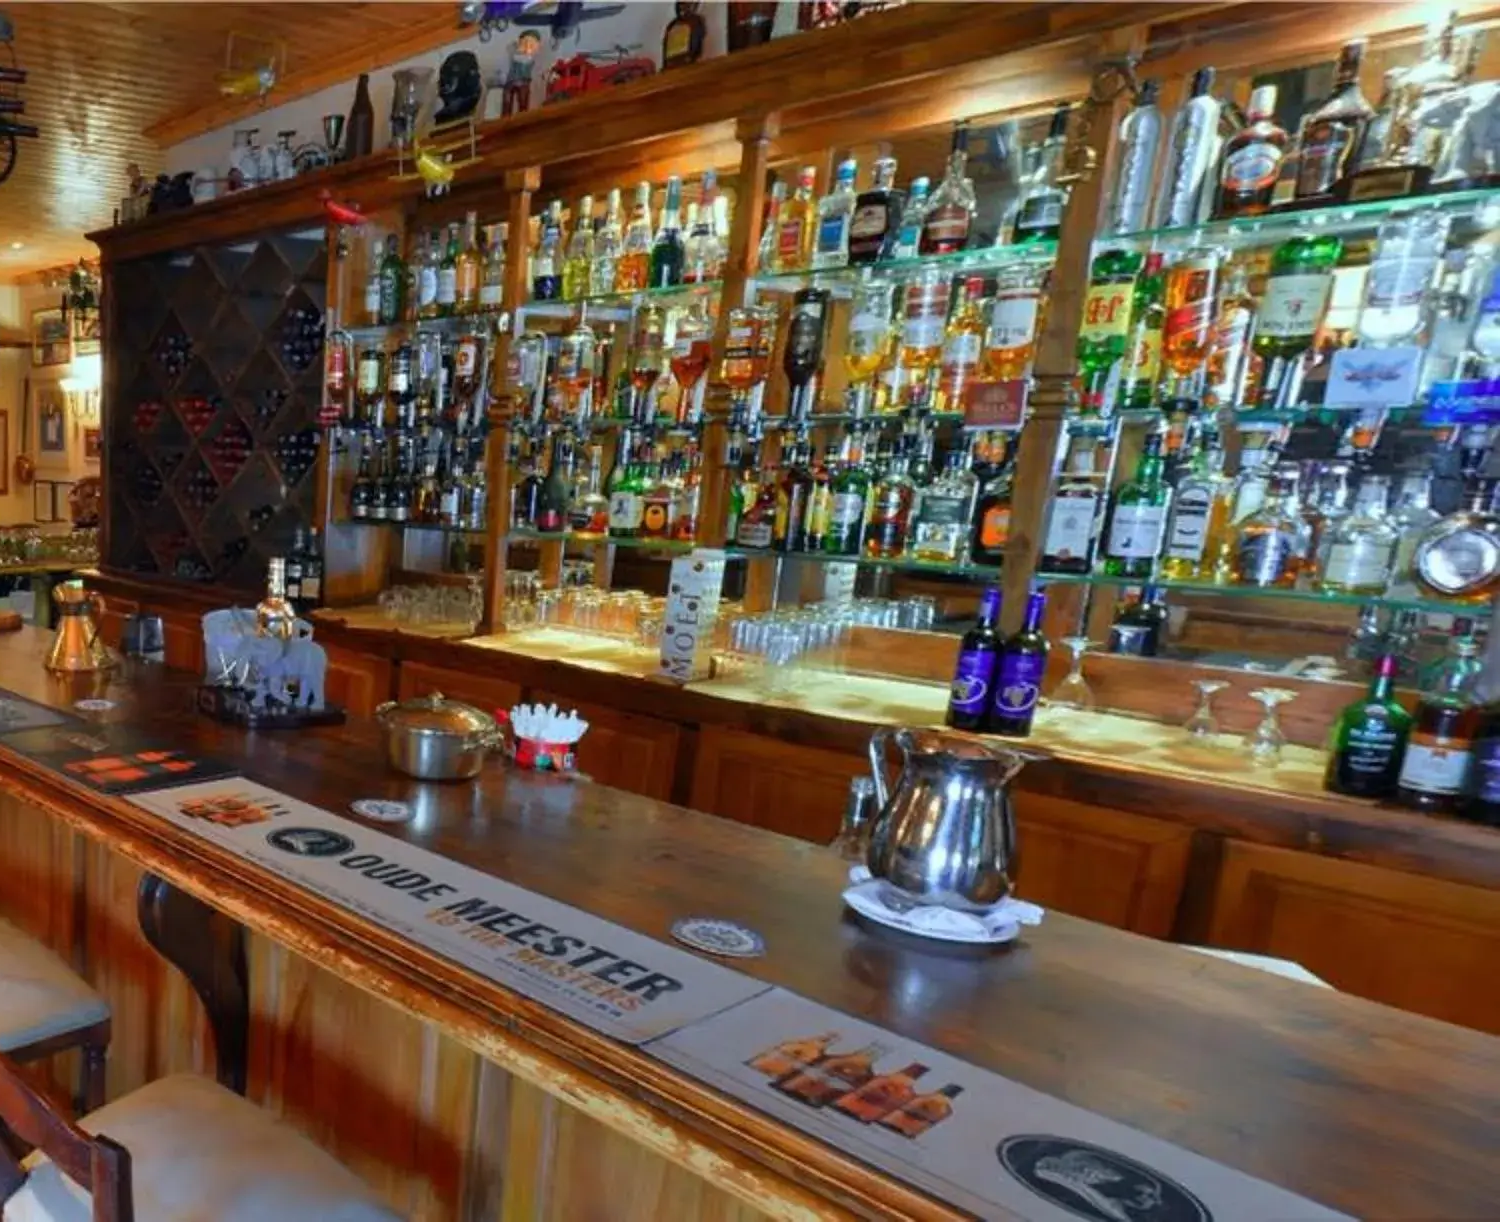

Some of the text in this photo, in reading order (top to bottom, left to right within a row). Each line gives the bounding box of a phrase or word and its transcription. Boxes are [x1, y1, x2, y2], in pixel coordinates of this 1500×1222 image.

[339, 854, 458, 902] OUDE
[443, 897, 684, 1001] MEESTER
[510, 947, 639, 1011] MASTERS
